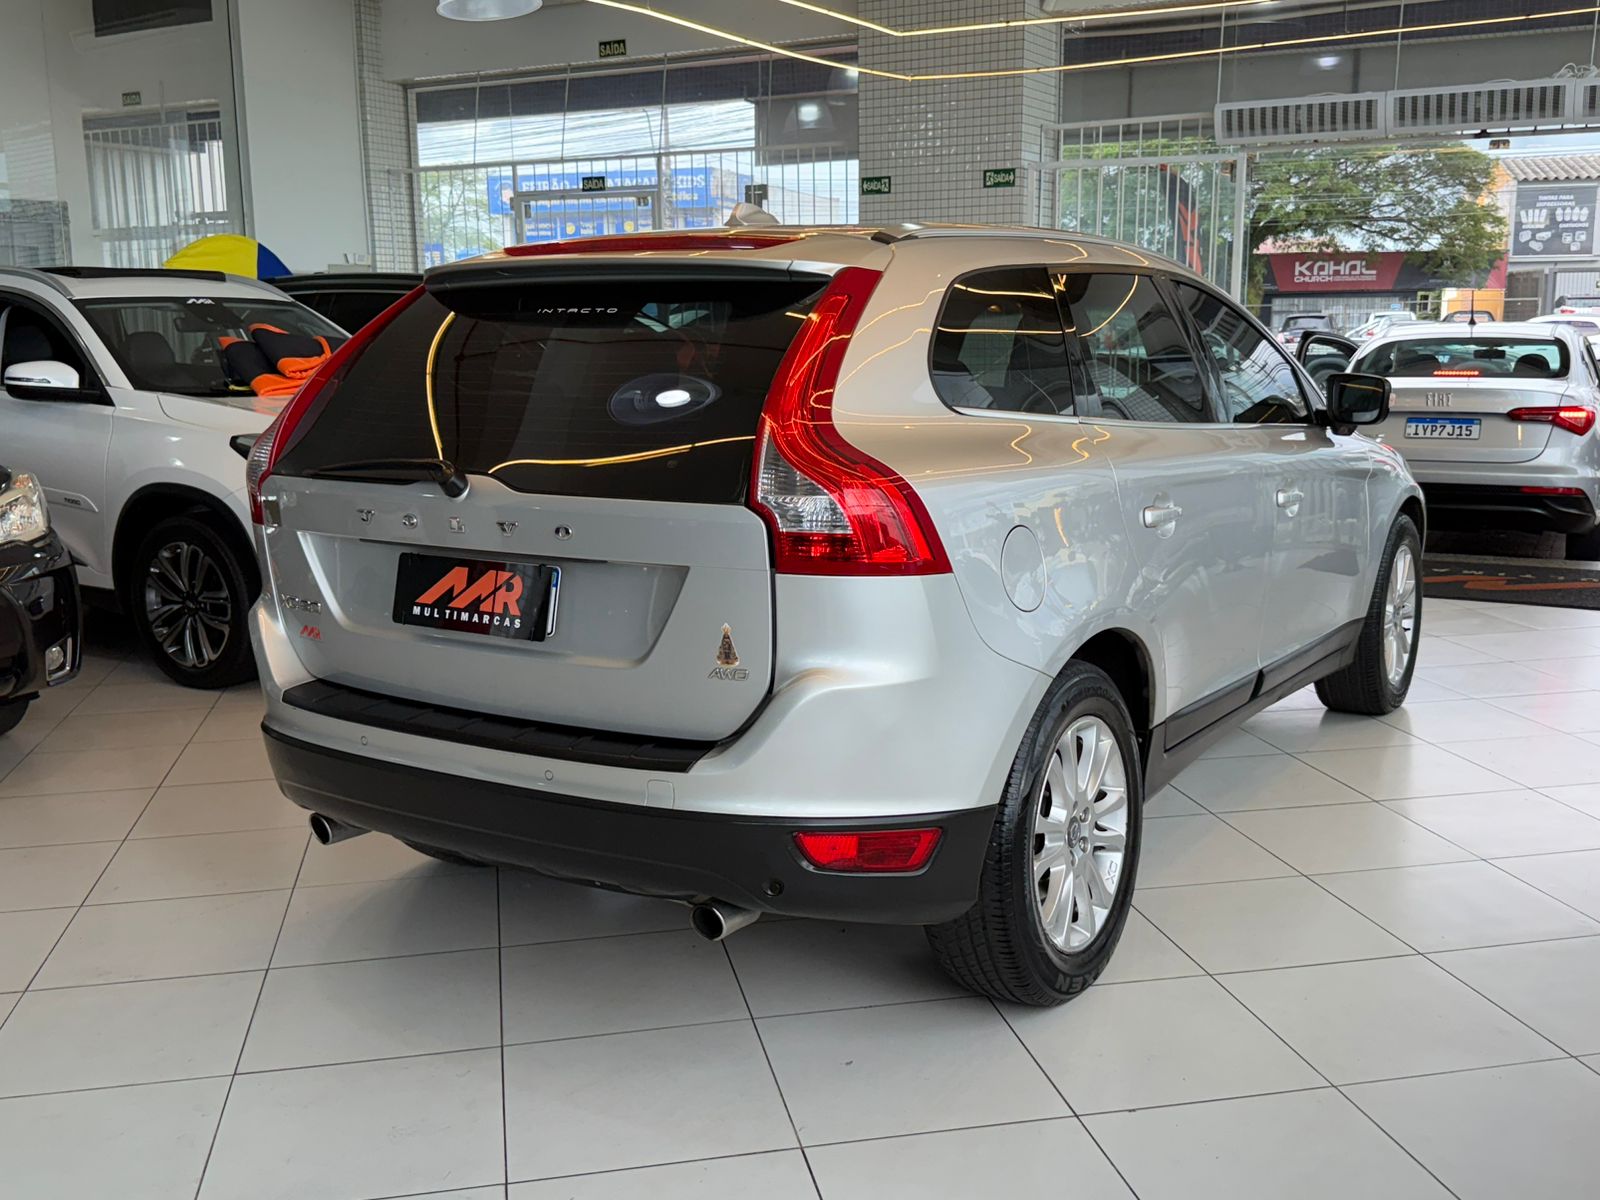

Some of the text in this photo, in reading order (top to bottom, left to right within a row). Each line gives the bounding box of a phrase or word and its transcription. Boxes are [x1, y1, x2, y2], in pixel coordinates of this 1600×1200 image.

[600, 42, 625, 56] SAÍDA
[583, 177, 604, 190] SAÍDA
[1294, 275, 1333, 283] CHURCH
[1426, 391, 1453, 407] FIAT
[1412, 424, 1473, 437] IYP7J15
[357, 508, 573, 541] VOLVO
[412, 604, 522, 629] MULTIMARCAS
[707, 667, 749, 681] AWD
